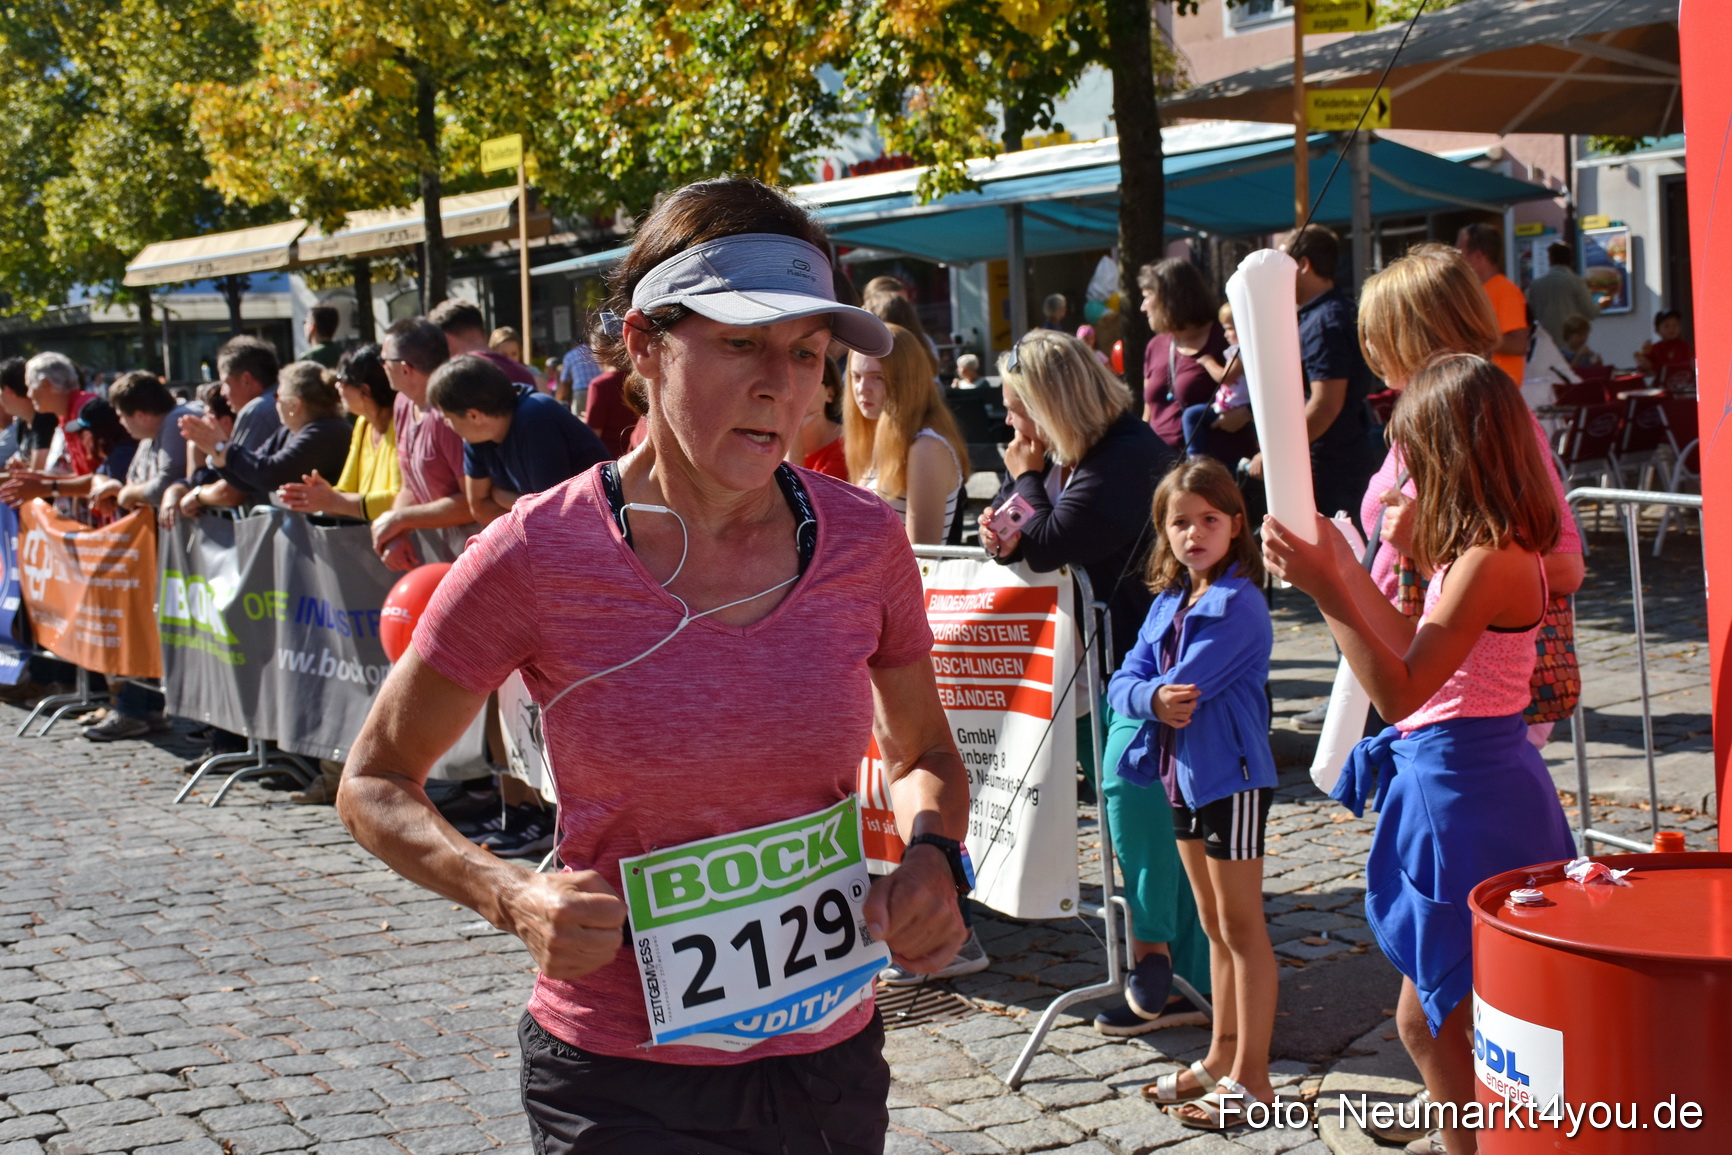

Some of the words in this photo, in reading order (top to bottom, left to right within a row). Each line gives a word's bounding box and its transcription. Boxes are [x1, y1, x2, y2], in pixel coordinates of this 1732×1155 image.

[930, 624, 1030, 642] ZURRSYSTEME
[933, 656, 1024, 675] DSCHLINGEN
[957, 728, 997, 745] GmbH
[1001, 751, 1006, 768] 8
[865, 816, 880, 832] ist
[649, 820, 842, 911] BOCK
[852, 884, 863, 898] D
[672, 889, 856, 1009] 2129
[733, 985, 844, 1033] UDITH
[1486, 1073, 1530, 1104] energie
